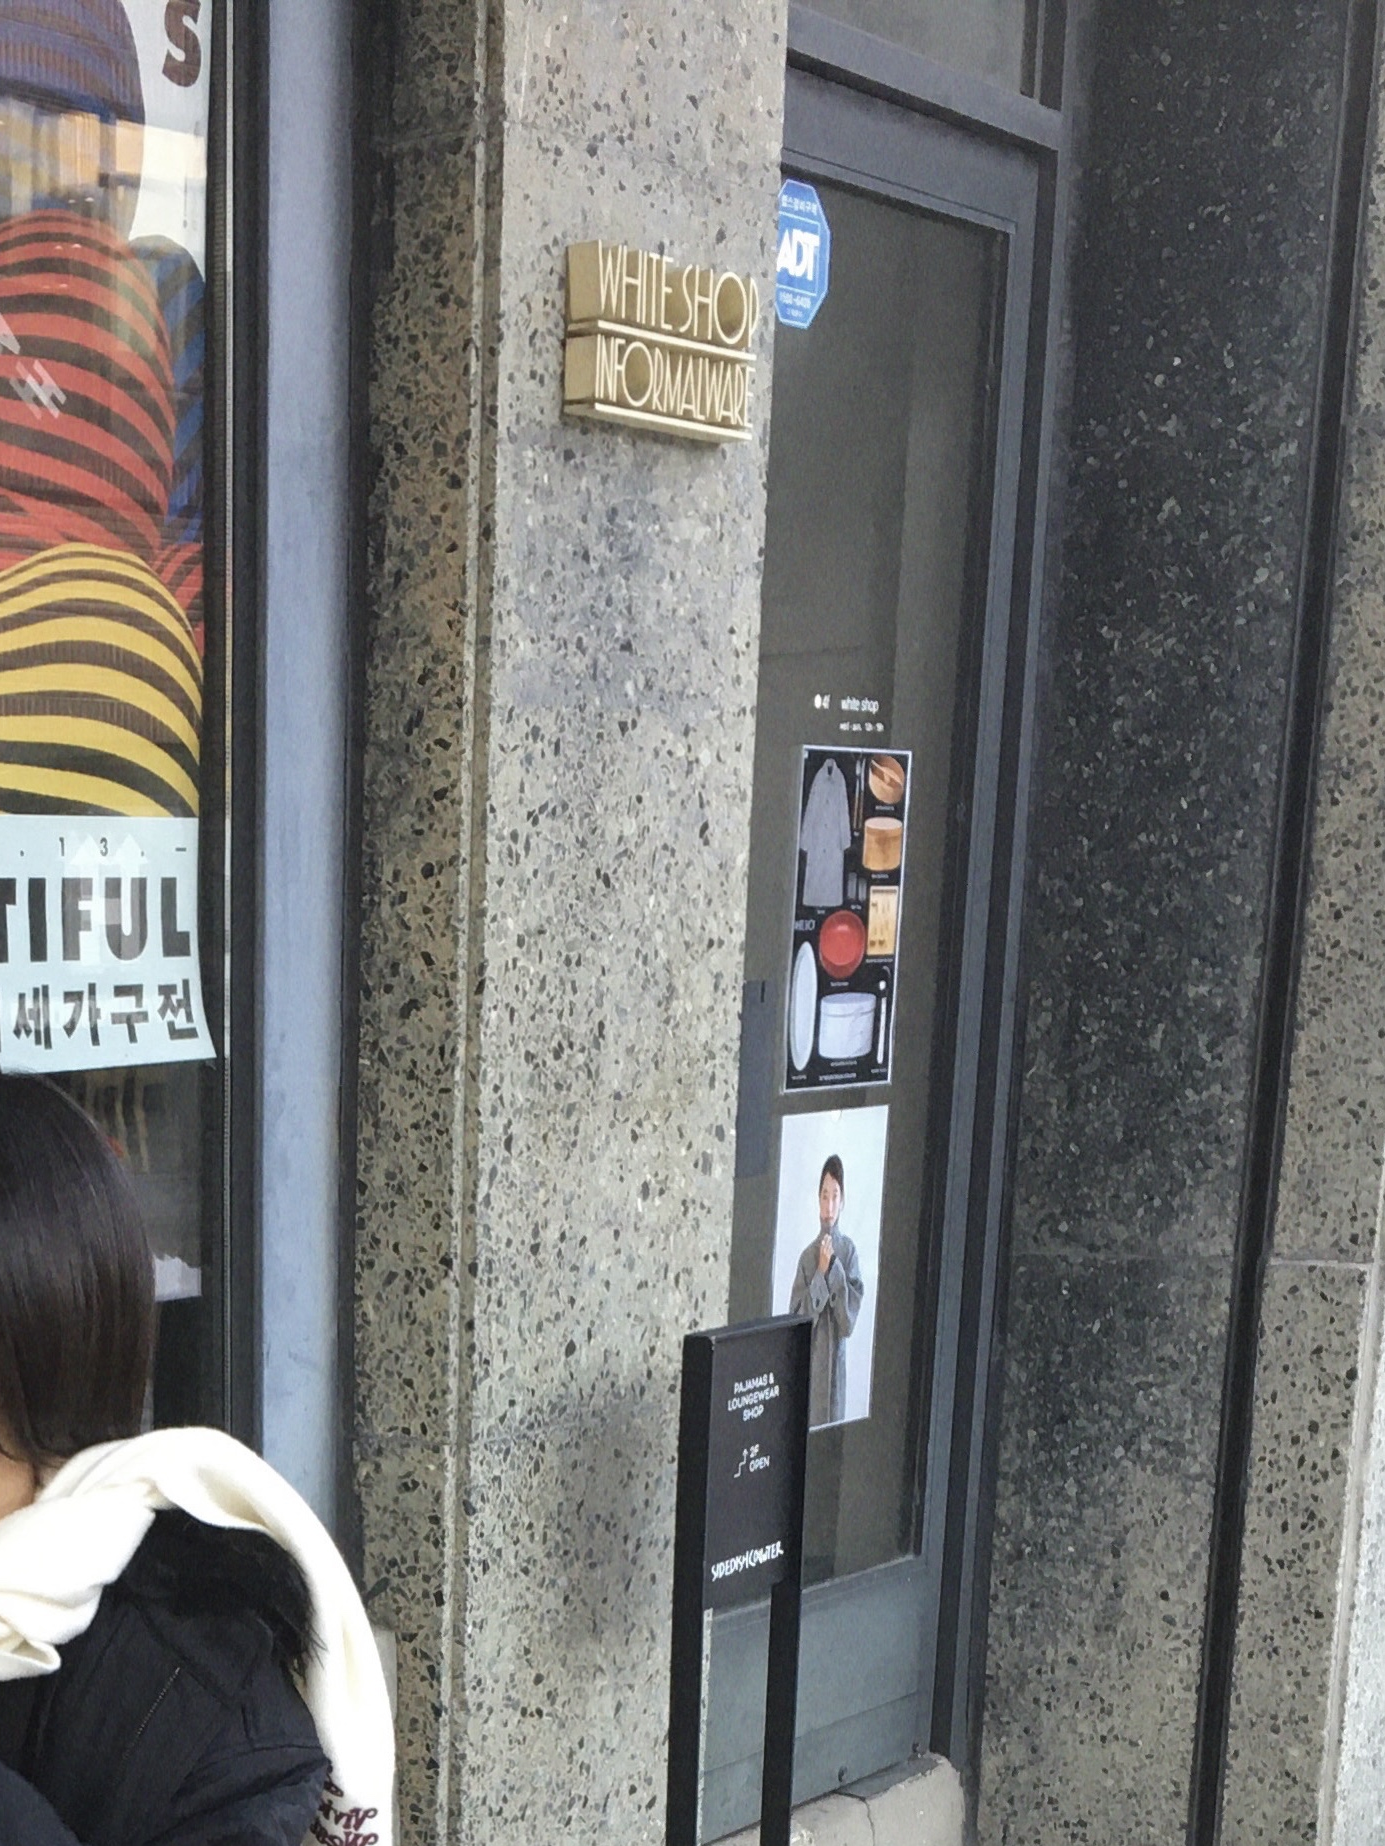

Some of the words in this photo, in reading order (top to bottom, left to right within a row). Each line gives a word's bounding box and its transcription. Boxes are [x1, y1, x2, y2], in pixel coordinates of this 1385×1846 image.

[776, 229, 820, 281] ADT
[598, 239, 674, 330] WHITE
[679, 264, 760, 348] SHOP
[734, 1373, 768, 1395] PAJAMAS
[727, 1384, 780, 1412] LOUNGEWEAR
[742, 1404, 764, 1422] SHOP
[749, 1455, 770, 1472] OPEN
